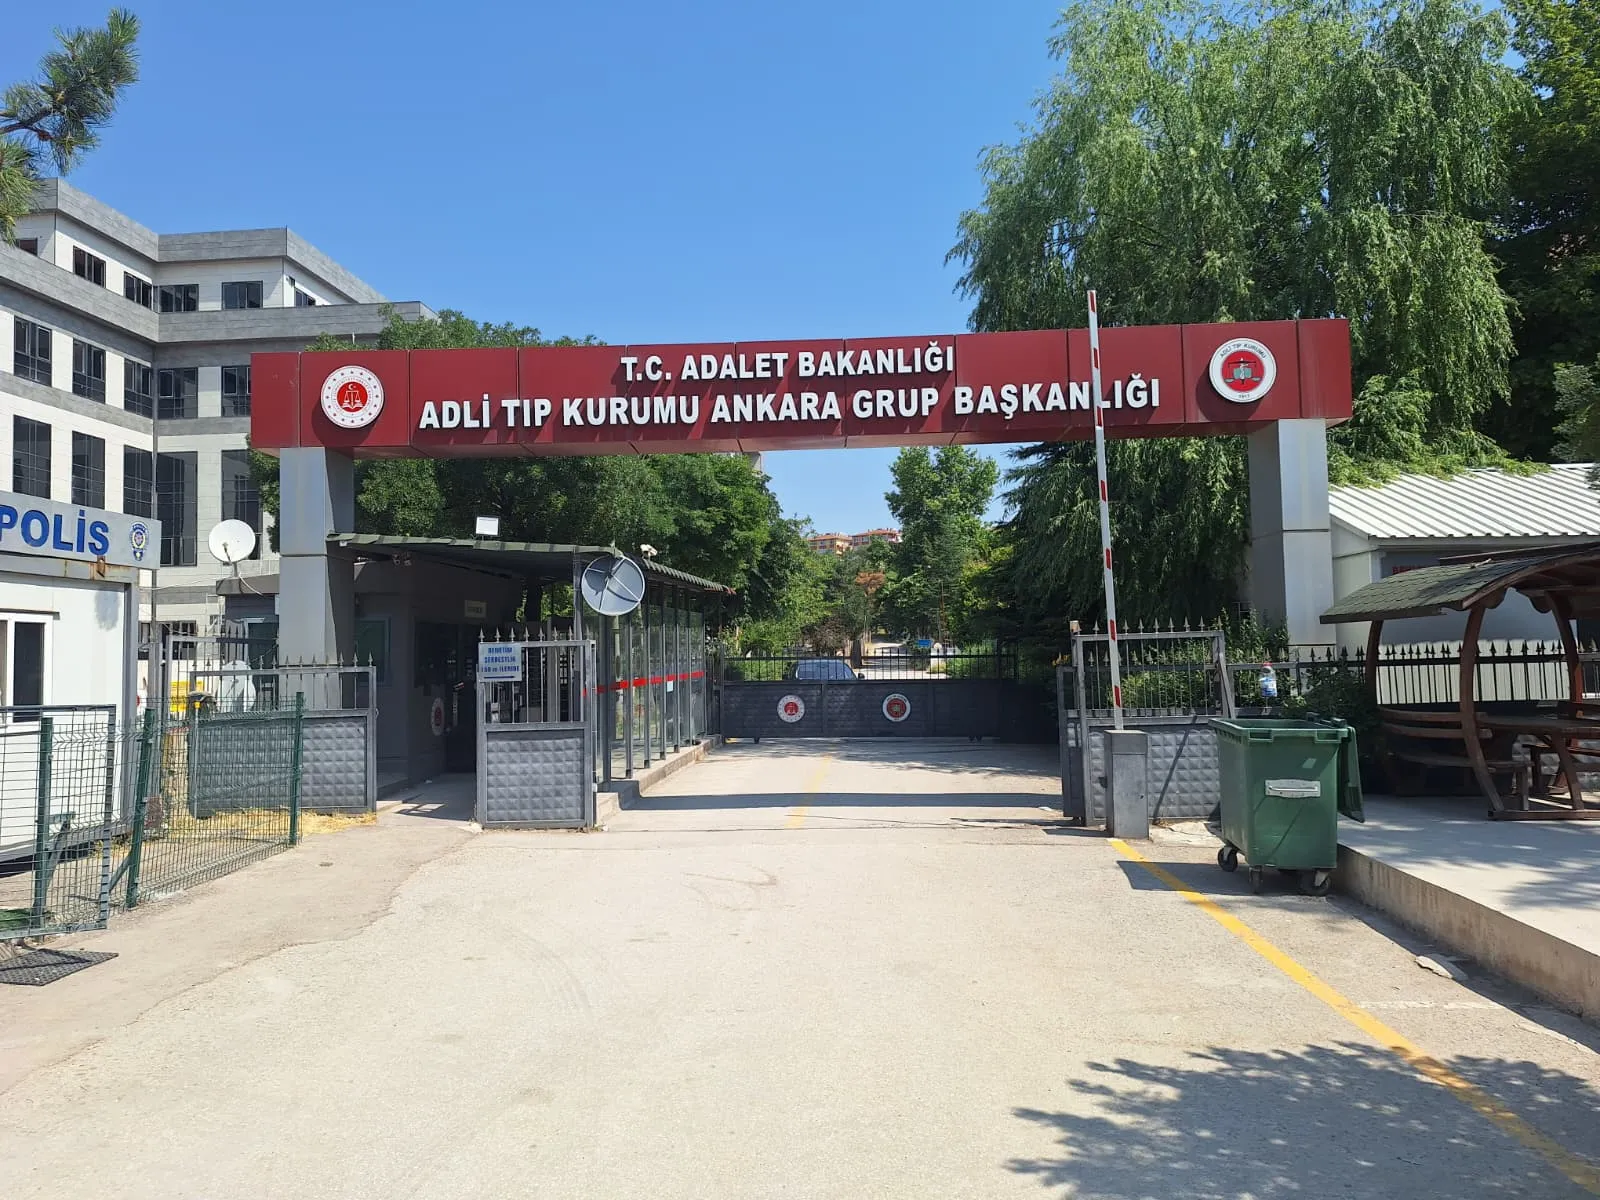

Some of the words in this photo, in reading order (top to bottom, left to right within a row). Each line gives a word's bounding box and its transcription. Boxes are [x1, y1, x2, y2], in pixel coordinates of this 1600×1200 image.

[620, 356, 672, 382] T.C.
[680, 351, 788, 380] ADALET
[798, 340, 955, 378] BAKANLIĞI
[419, 393, 490, 429] ADLİ
[500, 397, 552, 427] TIP
[562, 395, 699, 427] KURUMU
[710, 391, 842, 424] ANKARA
[852, 387, 939, 420] GRUP
[0, 505, 109, 556] POLİS
